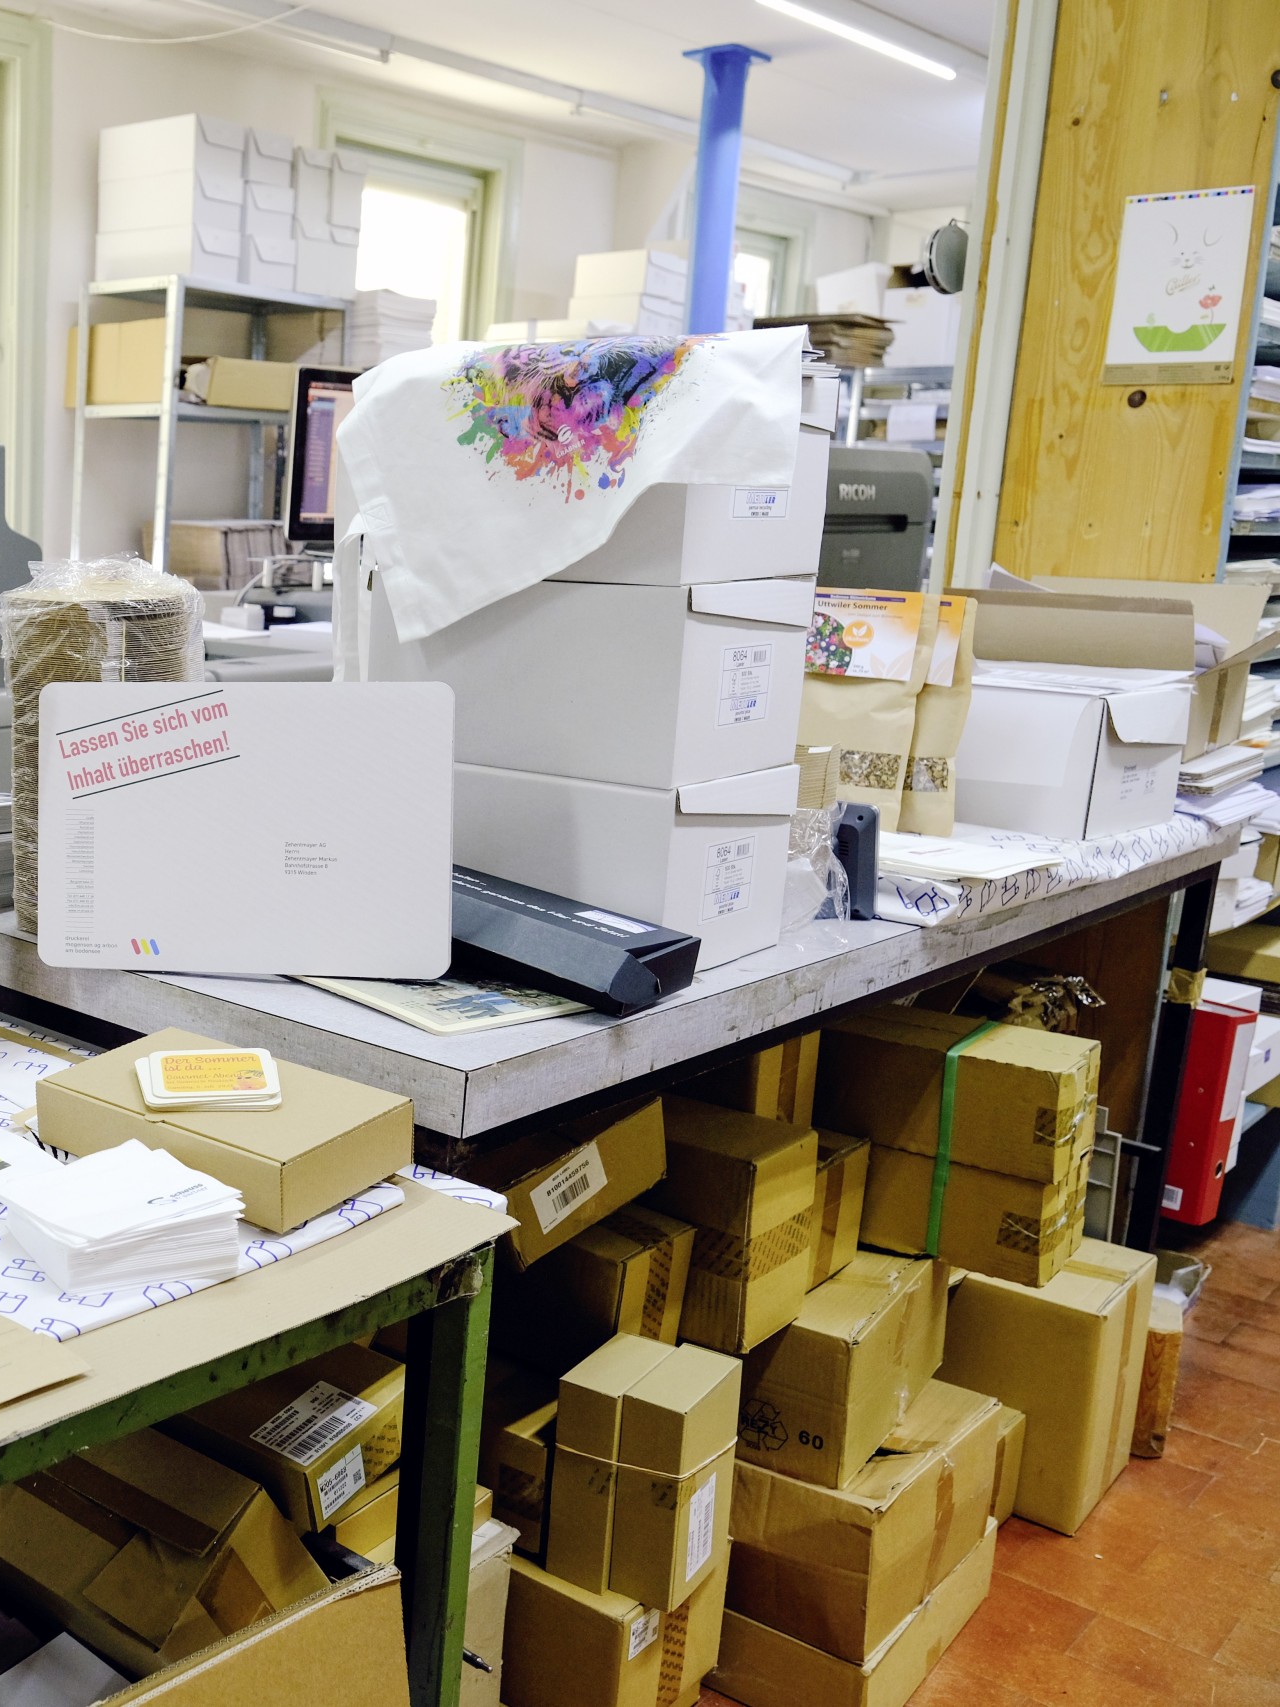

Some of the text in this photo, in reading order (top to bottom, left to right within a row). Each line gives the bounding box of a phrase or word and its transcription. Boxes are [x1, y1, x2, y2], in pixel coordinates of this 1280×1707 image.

[838, 483, 876, 501] RICOH
[817, 600, 888, 611] Uttwiler Sommer
[58, 702, 229, 759] Lassen Sie sich vom
[67, 730, 231, 790] Inhalt überraschen!
[184, 1063, 204, 1072] da
[194, 1055, 257, 1064] Sommer
[798, 1429, 824, 1450] 60
